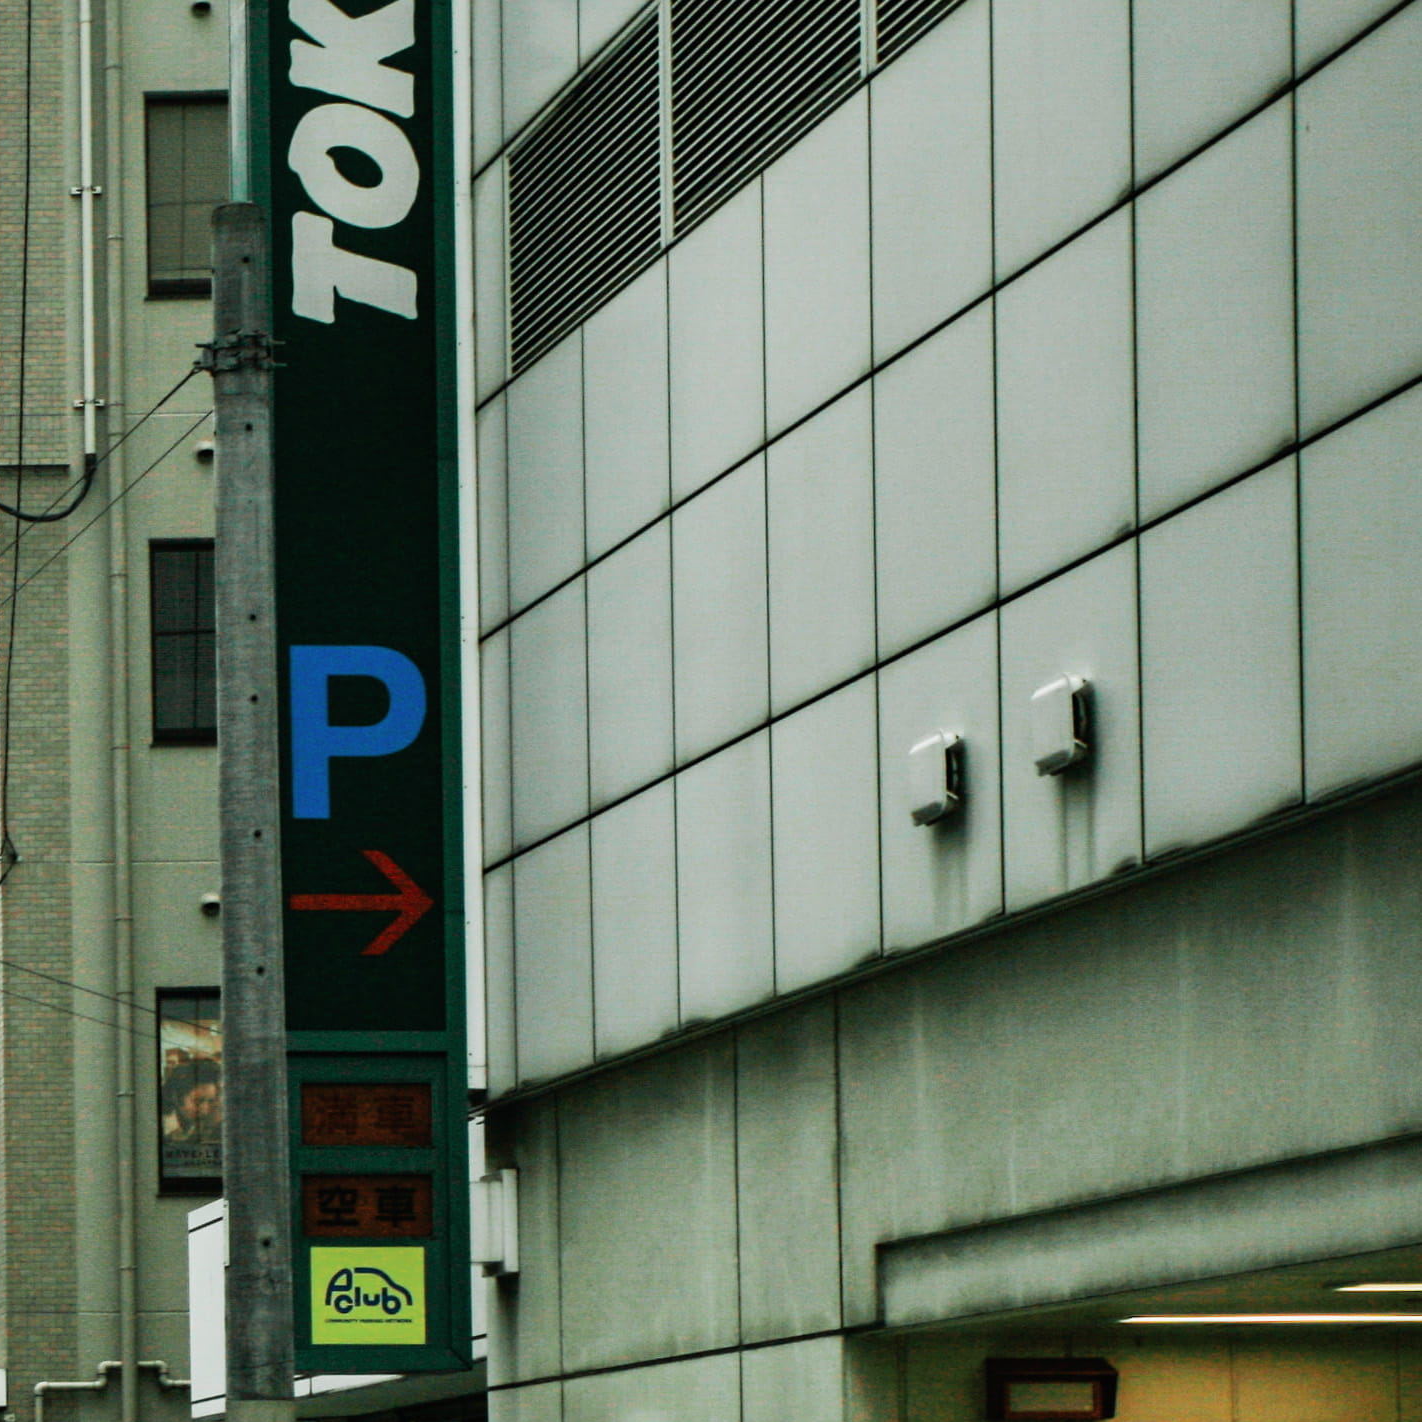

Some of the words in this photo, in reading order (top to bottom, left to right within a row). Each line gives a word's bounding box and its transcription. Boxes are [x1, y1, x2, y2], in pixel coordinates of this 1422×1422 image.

[288, 0, 420, 324] TOK
[288, 645, 427, 820] P
[317, 1185, 417, 1227] 空車
